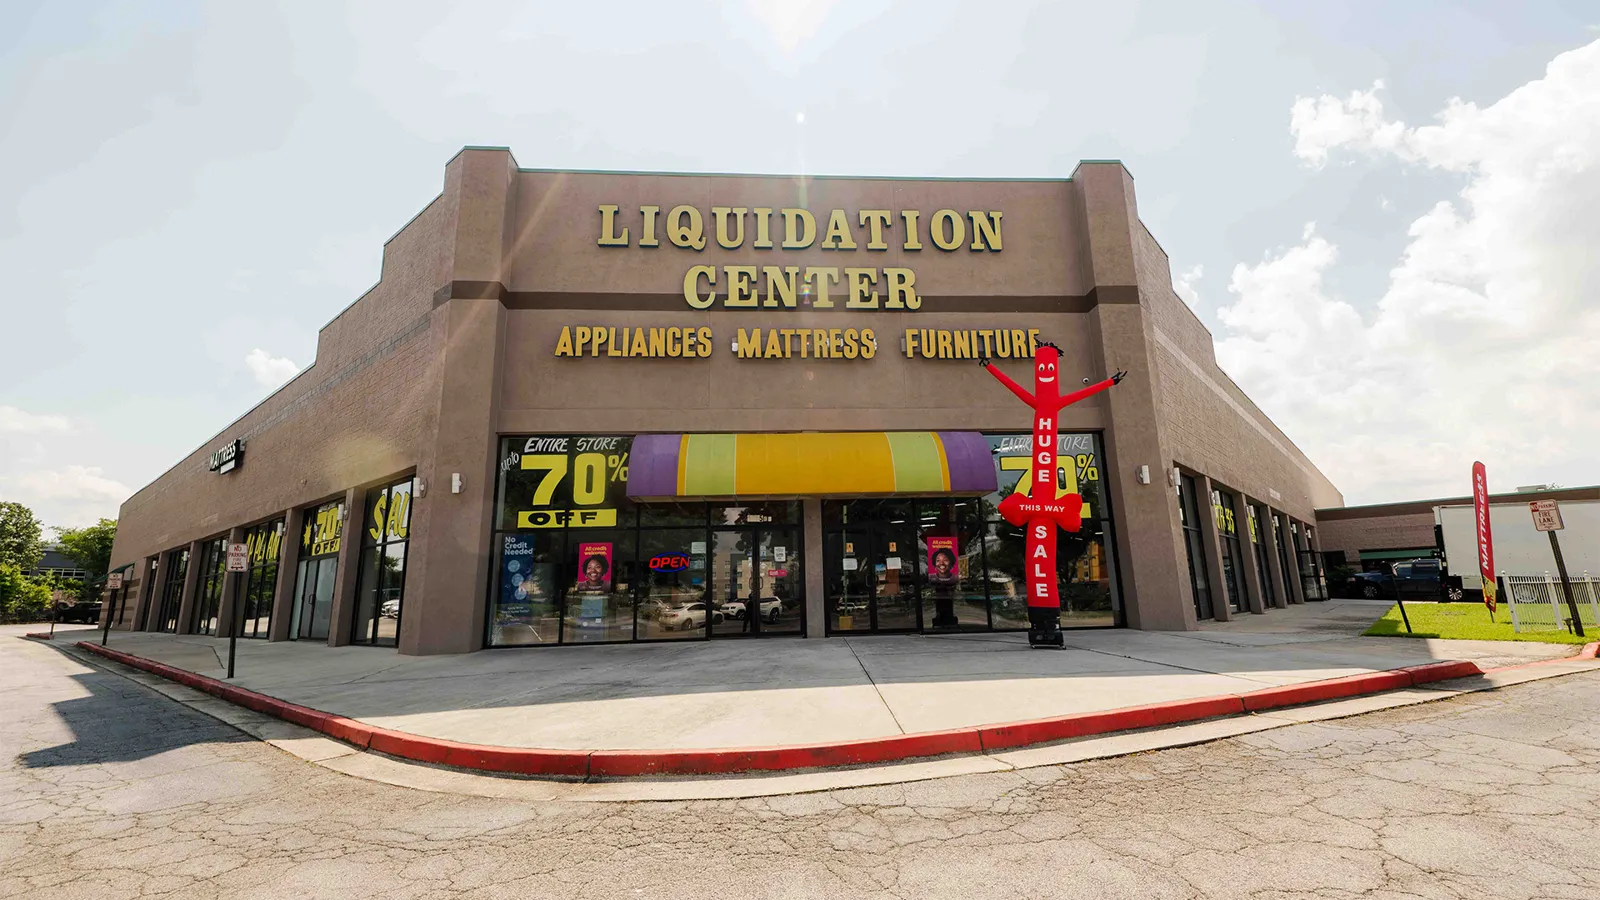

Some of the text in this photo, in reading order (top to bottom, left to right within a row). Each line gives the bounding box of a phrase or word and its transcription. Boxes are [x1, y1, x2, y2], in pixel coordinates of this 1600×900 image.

[597, 204, 1003, 252] LIQUIDATION
[683, 265, 922, 310] CENTER
[554, 325, 713, 358] APPLIANCES
[737, 327, 876, 360] MATTRESS
[524, 437, 619, 453] ENTIRE STORE
[1000, 436, 1089, 453] ENTIR TORE
[1038, 418, 1052, 482] HUGE
[369, 491, 411, 541] SAL
[528, 512, 598, 526] OFF
[1044, 505, 1065, 513] WAY
[504, 548, 533, 556] Needed
[649, 556, 691, 569] OPEN
[1034, 526, 1049, 598] SALE
